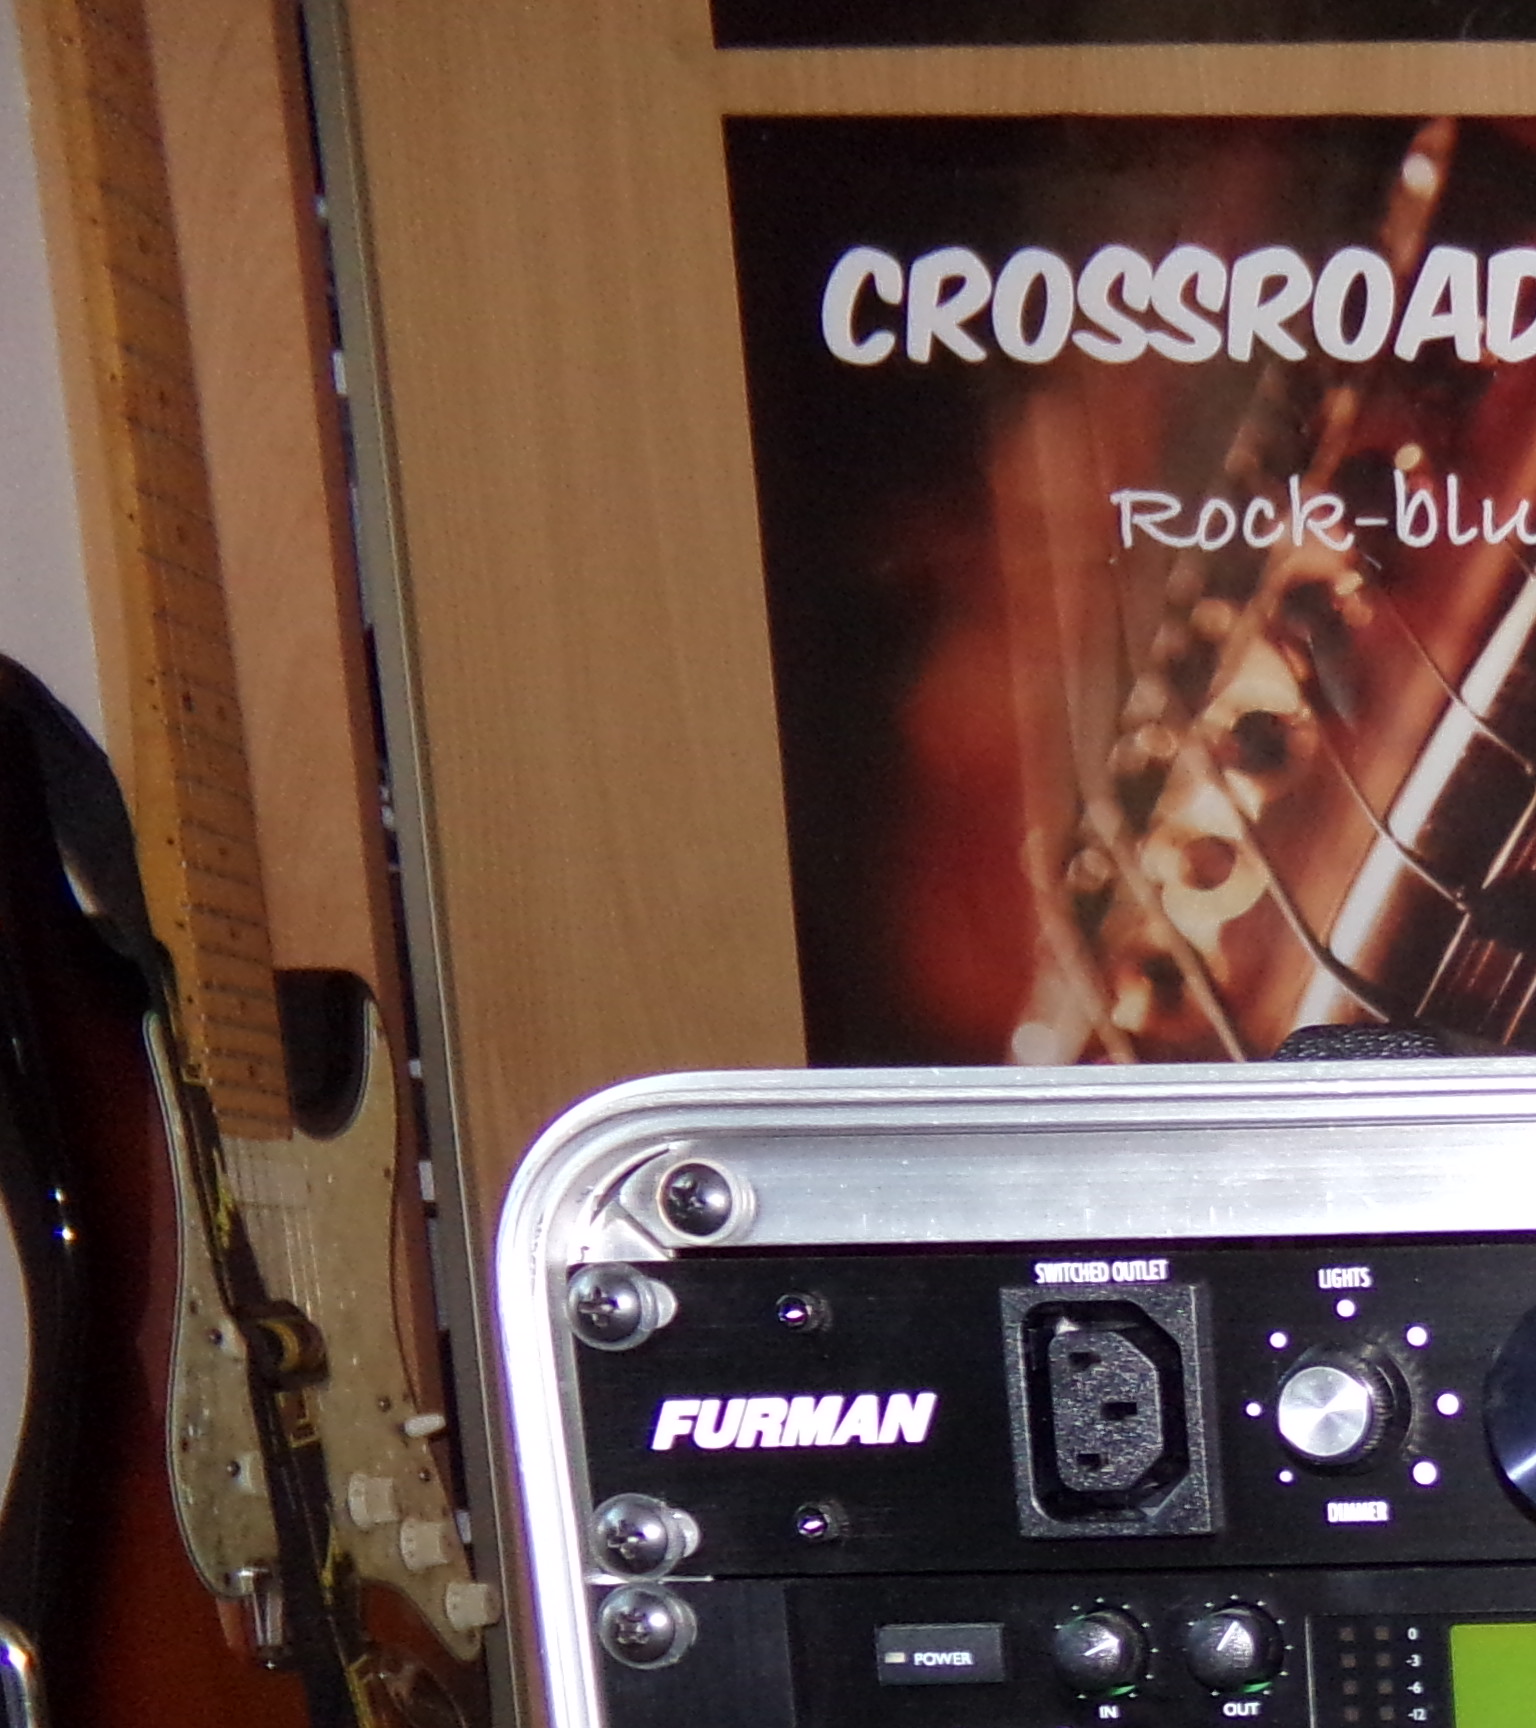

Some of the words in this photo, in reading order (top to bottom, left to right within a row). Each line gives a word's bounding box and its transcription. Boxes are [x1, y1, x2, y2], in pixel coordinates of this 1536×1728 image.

[1034, 1261, 1109, 1284] SWITCHED
[1112, 1258, 1170, 1282] OUTLET
[1318, 1267, 1372, 1289] LIGHTS
[651, 1392, 938, 1451] FURMAN
[1327, 1502, 1389, 1523] DIMMER
[1407, 1627, 1418, 1640] 0
[913, 1651, 973, 1666] POWER
[1405, 1654, 1422, 1667] -3
[1406, 1682, 1423, 1694] -6
[1099, 1706, 1119, 1719] IN
[1223, 1702, 1261, 1717] OUT
[1407, 1709, 1428, 1721] -12
